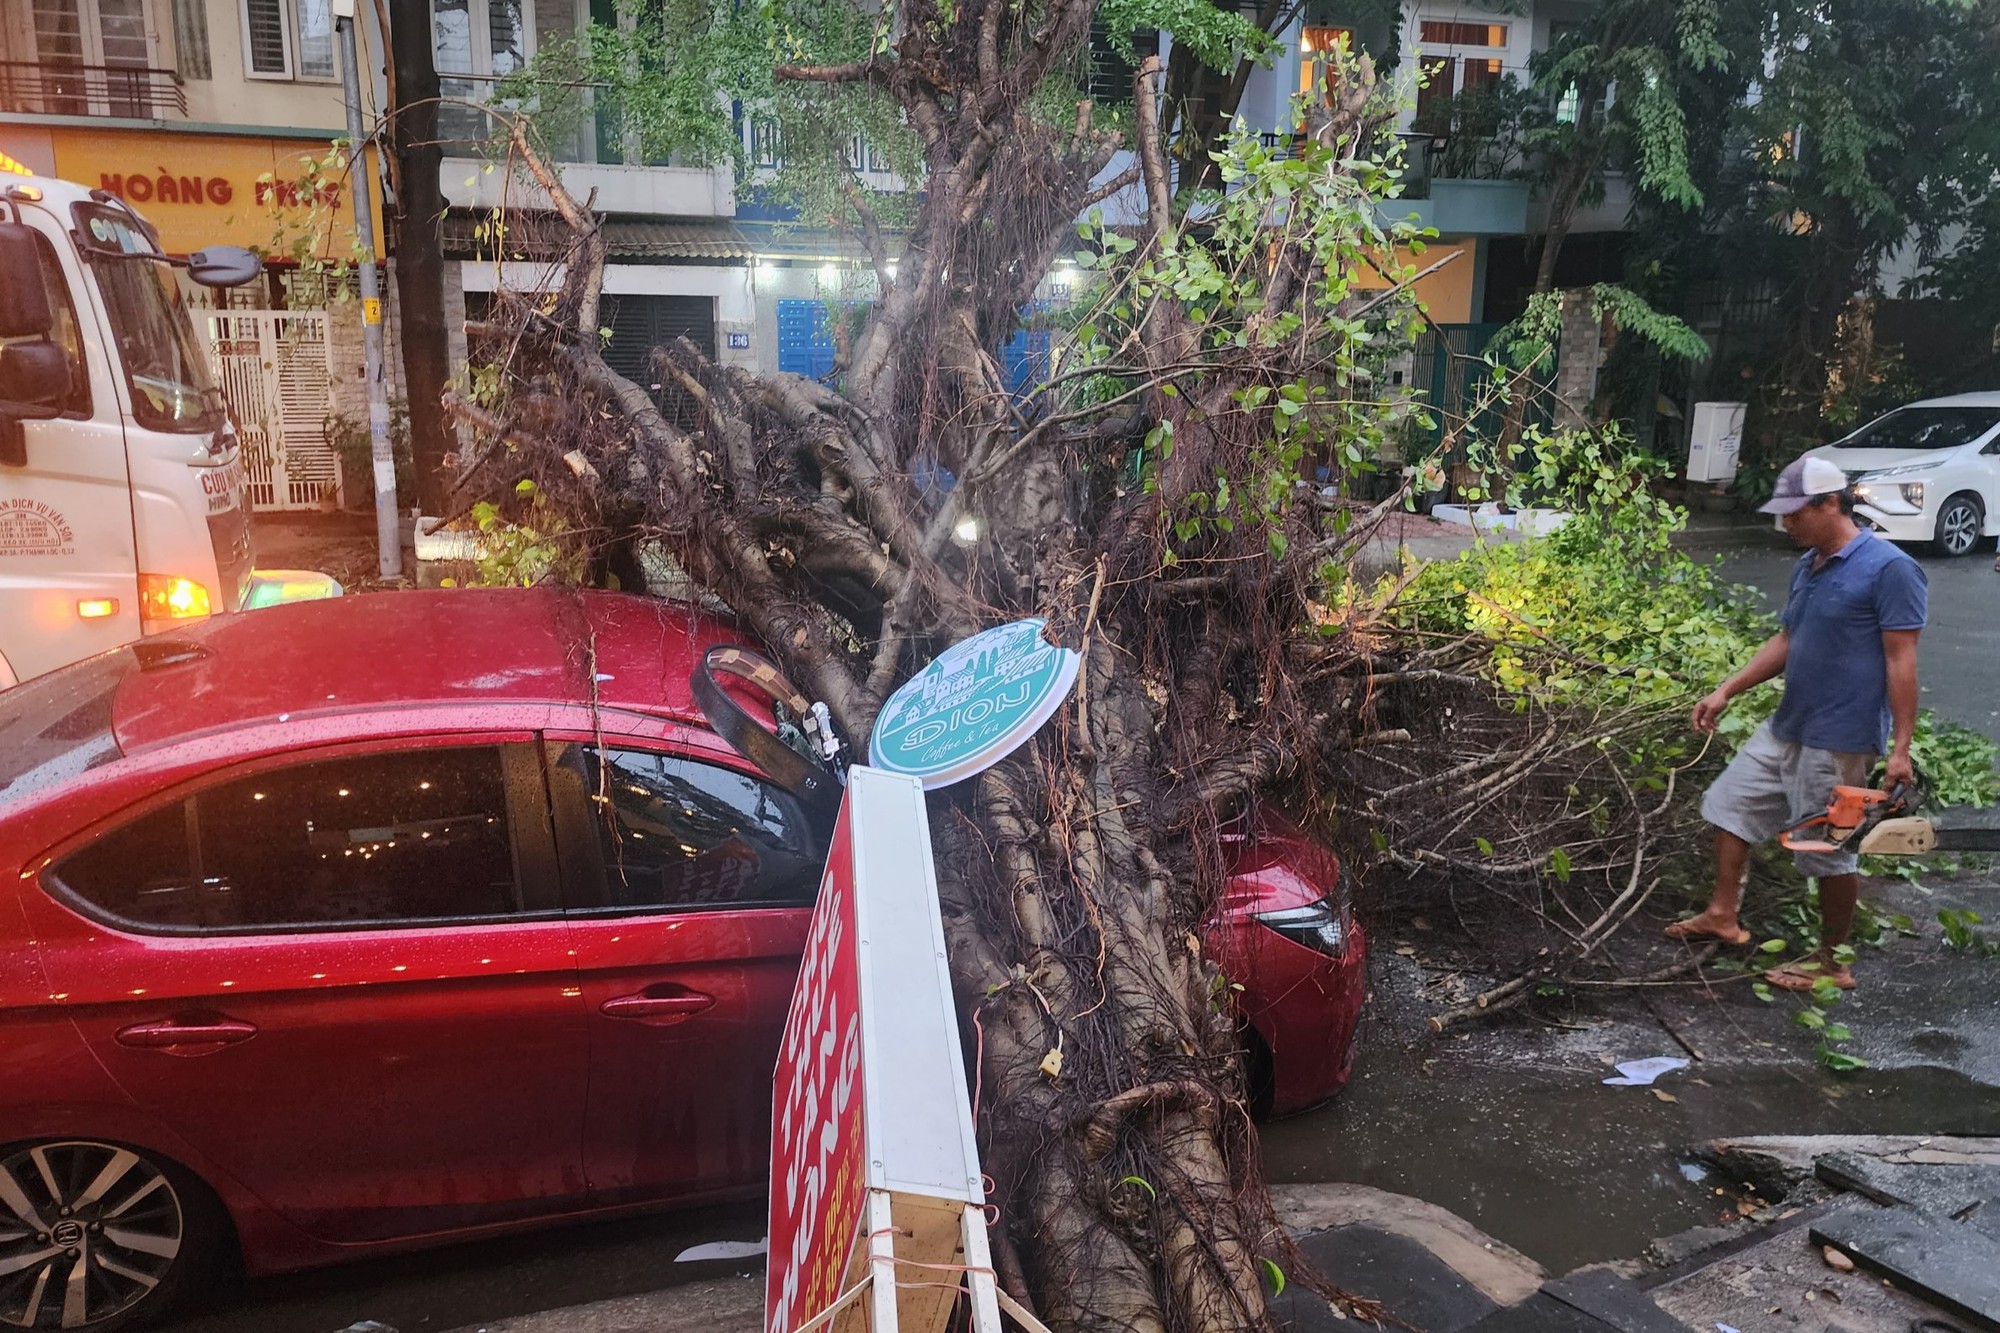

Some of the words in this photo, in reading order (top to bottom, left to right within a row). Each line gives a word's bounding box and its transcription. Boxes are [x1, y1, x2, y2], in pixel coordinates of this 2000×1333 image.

[100, 166, 232, 205] HOÀNG
[728, 334, 748, 348] 136
[900, 681, 1031, 751] DION
[920, 737, 962, 763] Coffee
[964, 731, 975, 744] &
[979, 719, 1000, 739] Tea
[789, 870, 834, 1064] CHO
[780, 889, 843, 1157] THUÊ
[786, 991, 837, 1219] VĂN
